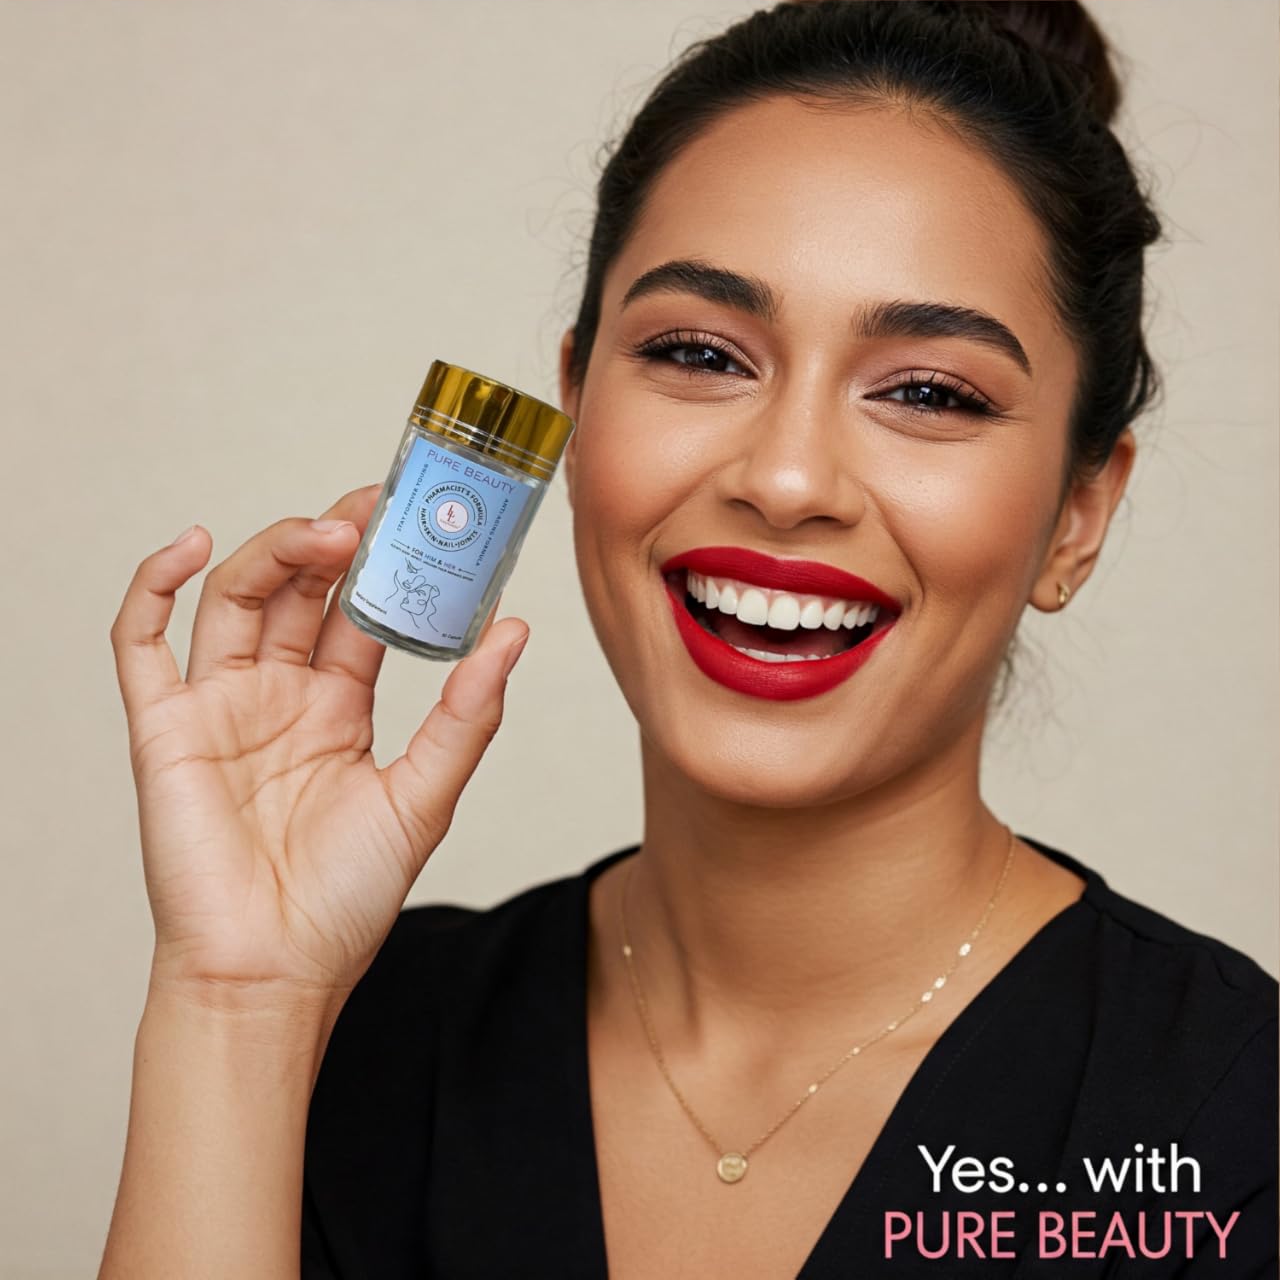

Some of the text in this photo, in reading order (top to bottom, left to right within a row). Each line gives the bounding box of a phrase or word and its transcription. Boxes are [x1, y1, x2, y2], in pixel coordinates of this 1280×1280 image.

[426, 449, 517, 495] PURE BEAUTY
[411, 547, 424, 557] FOR
